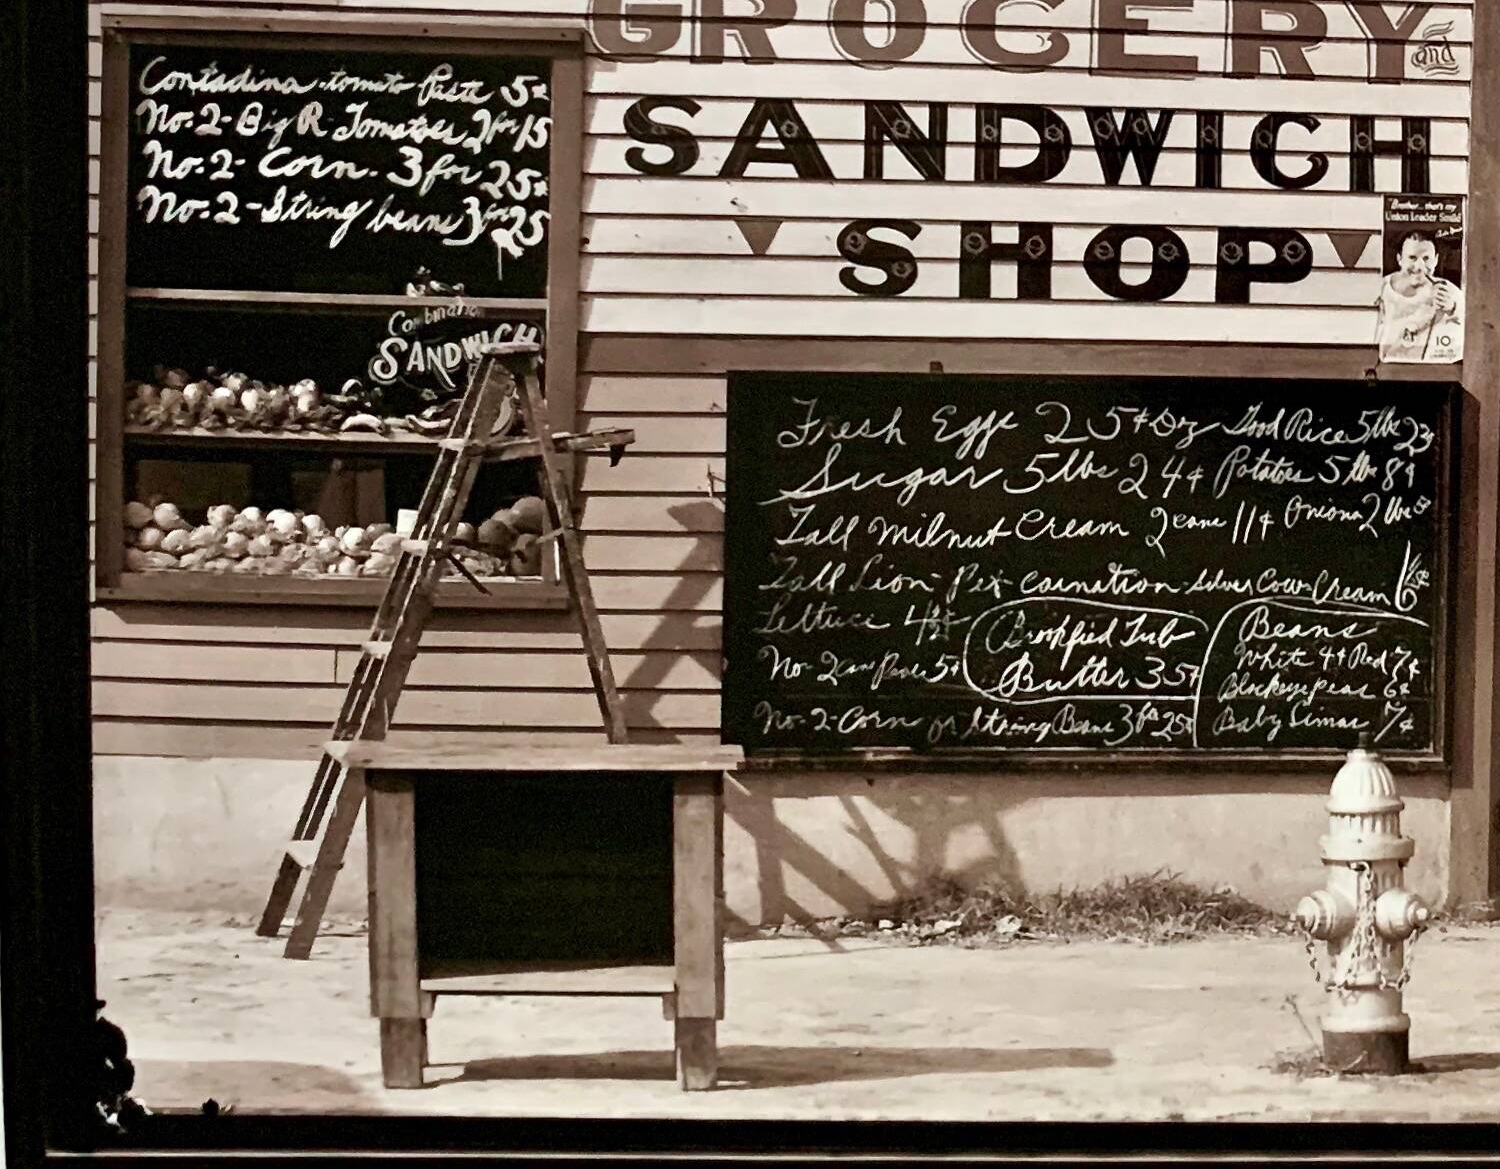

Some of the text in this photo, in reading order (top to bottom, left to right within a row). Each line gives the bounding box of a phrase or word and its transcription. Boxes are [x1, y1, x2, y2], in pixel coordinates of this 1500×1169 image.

[1411, 36, 1457, 69] and
[140, 56, 318, 96] Contadina
[417, 63, 495, 107] Paste
[236, 101, 298, 150] Big
[332, 102, 468, 145] Tomatoes
[623, 95, 1432, 194] SANDWICH
[387, 146, 423, 187] 3
[419, 154, 483, 196] for
[366, 194, 464, 234] beans
[1410, 212, 1437, 222] Leader
[837, 219, 1314, 305] SHOP
[777, 397, 906, 448] Fresh
[931, 405, 1018, 460] Eggs
[1285, 408, 1349, 445] Rice
[756, 443, 1004, 506] Sugar
[1212, 445, 1316, 499] Potatoes
[775, 504, 859, 551] Tall
[1014, 509, 1130, 541] Cream
[1284, 494, 1363, 530] Onions
[758, 557, 847, 596] Tall
[1311, 569, 1391, 606] Cream
[752, 593, 891, 633] Lettuce
[1119, 613, 1196, 649] Tub
[1239, 606, 1379, 644] Beans
[998, 651, 1130, 698] Butter
[1233, 642, 1315, 671] White
[1348, 642, 1388, 675] Red
[838, 706, 924, 734] Corn
[1213, 705, 1284, 742] Baby
